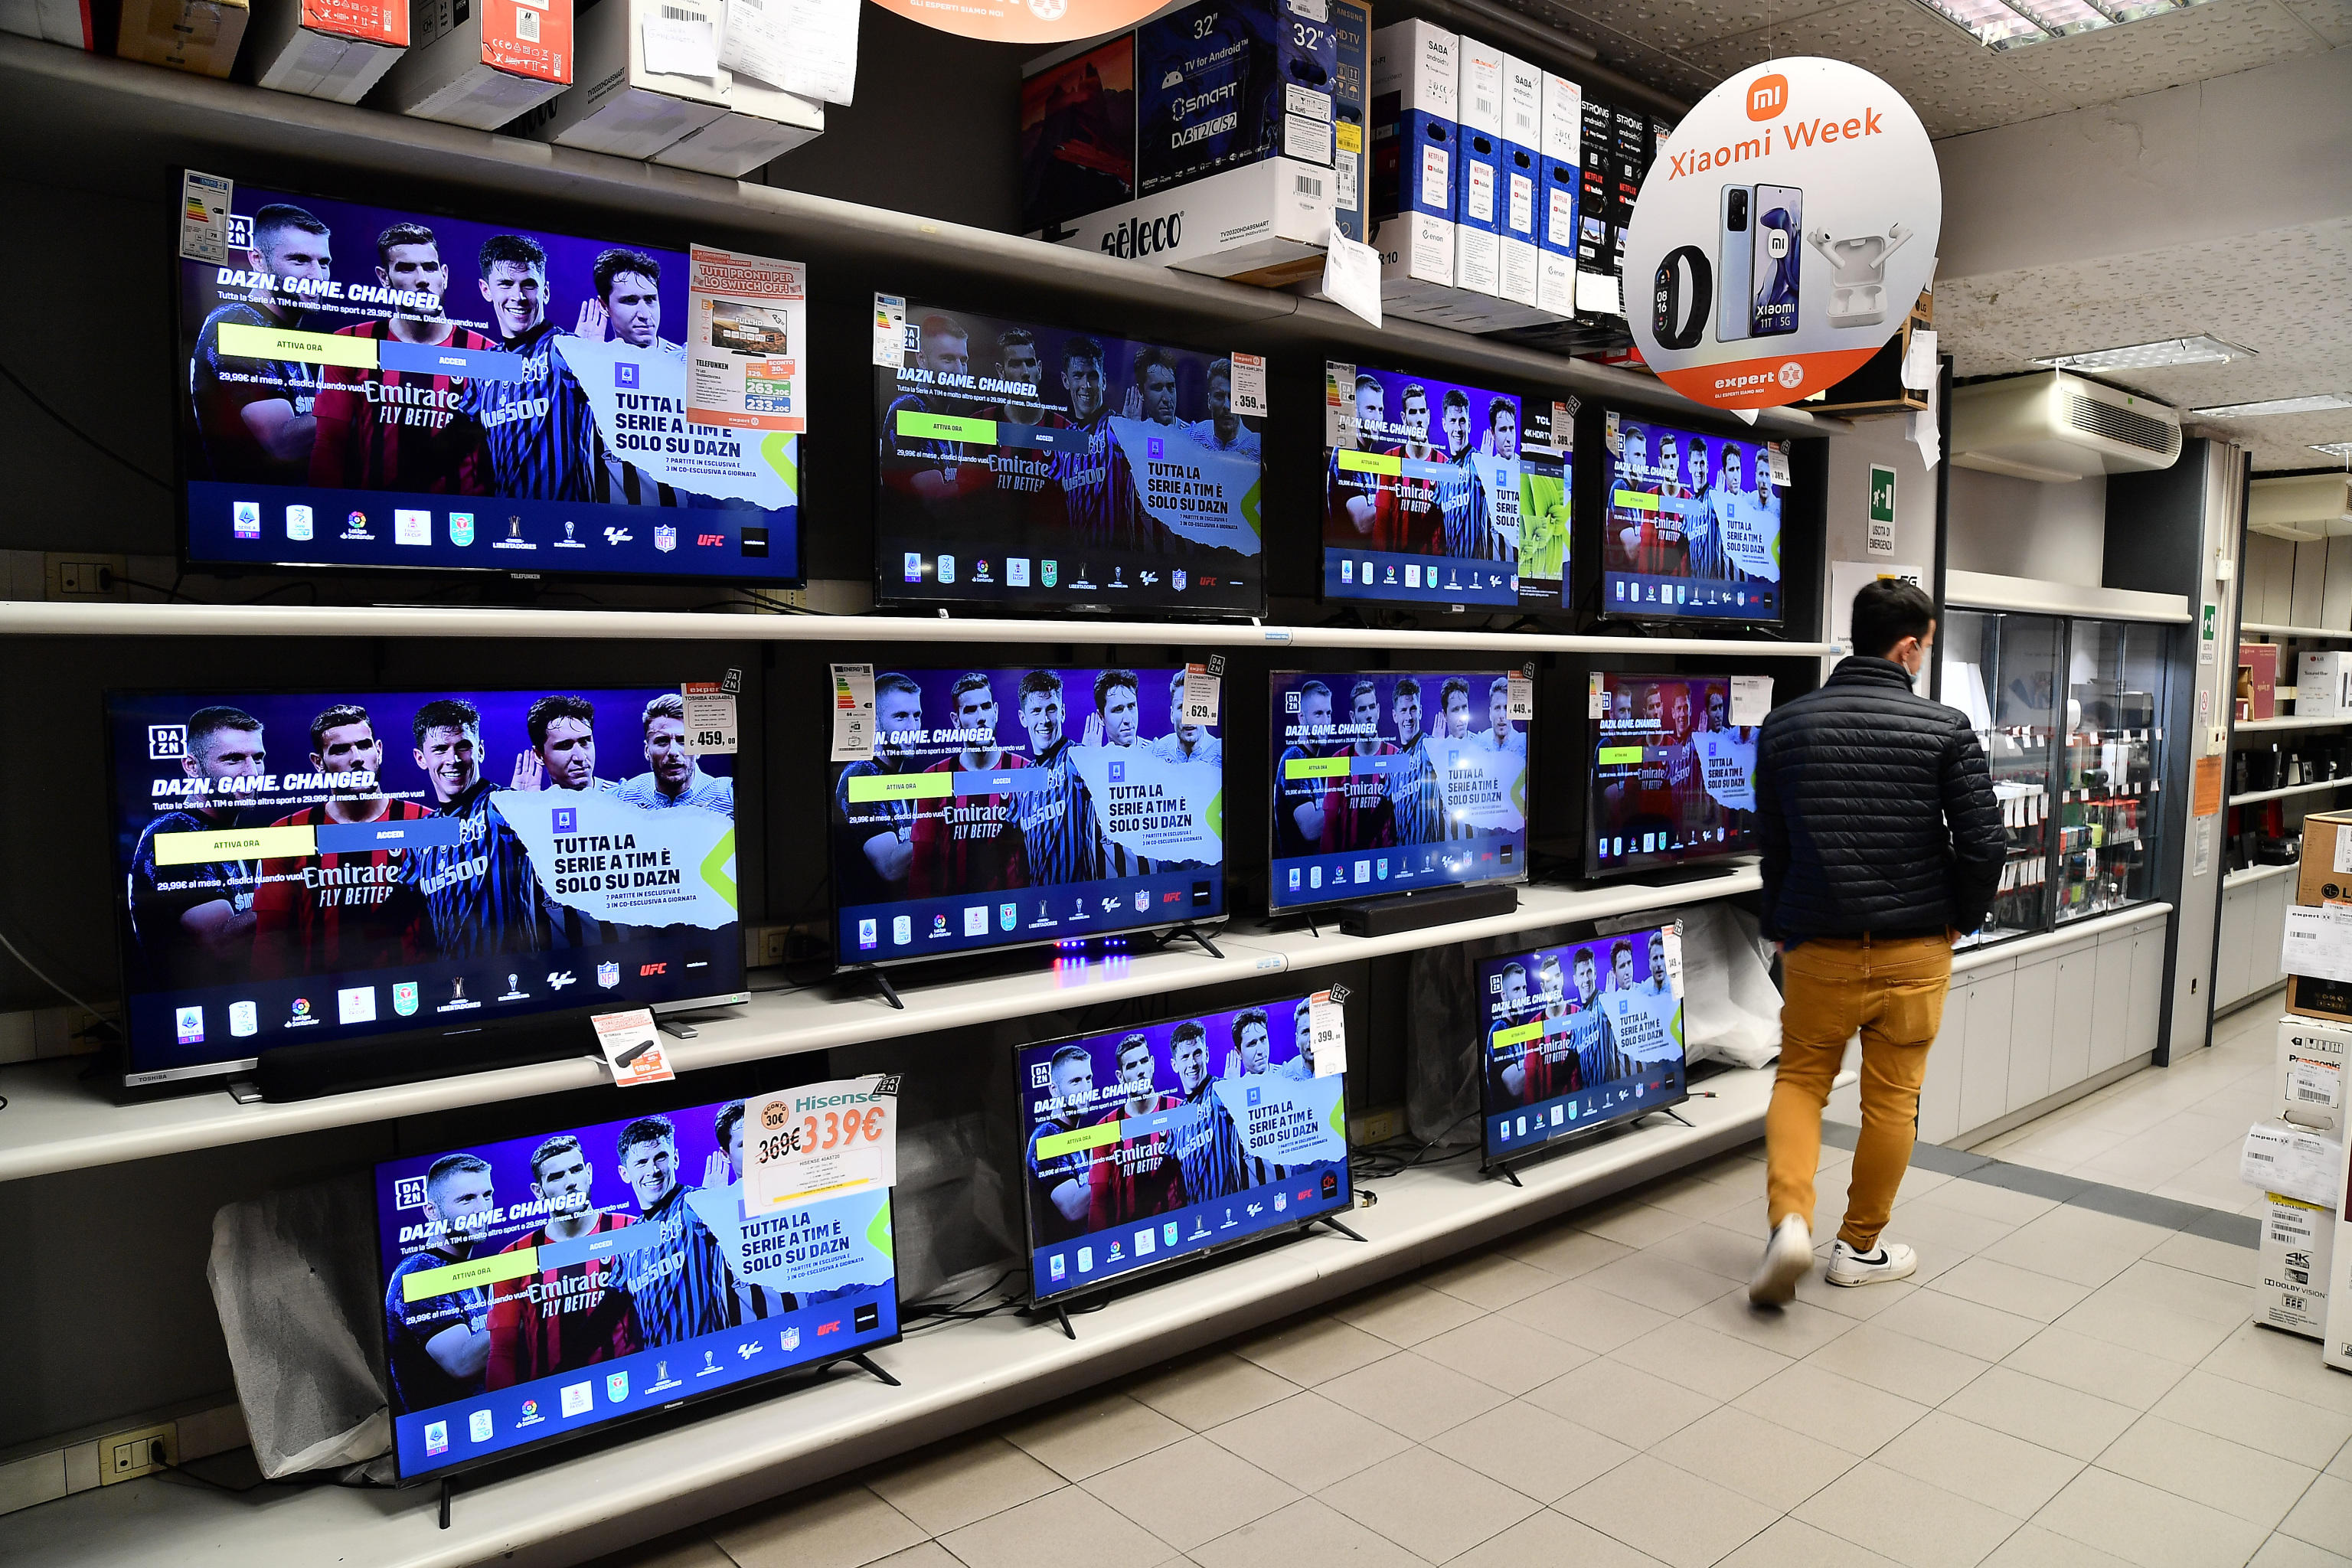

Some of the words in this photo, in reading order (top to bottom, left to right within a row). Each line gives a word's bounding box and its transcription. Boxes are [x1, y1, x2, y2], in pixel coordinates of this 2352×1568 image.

[926, 1, 959, 12] ESPERTI
[960, 6, 987, 15] SIAMO
[1336, 8, 1363, 22] AMSUNG
[1194, 12, 1217, 40] 32"
[1293, 23, 1324, 51] 32"
[1428, 41, 1449, 56] SABA
[1184, 60, 1195, 73] TV
[1197, 56, 1209, 69] for
[1515, 75, 1533, 90] SABA
[1295, 106, 1306, 115] RoHS
[1582, 100, 1610, 118] STRONG
[1616, 113, 1643, 132] STRONG
[1668, 129, 1772, 181] Xiaomi
[1784, 107, 1883, 150] Week
[1428, 152, 1444, 163] NETFLIX
[1474, 166, 1489, 177] NETFLIX
[1584, 171, 1603, 185] NETFLIX
[1619, 181, 1637, 196] NETFLIX
[1430, 234, 1443, 243] erion
[699, 265, 728, 278] TUTTI
[730, 269, 770, 283] PRONTI
[773, 272, 794, 283] PER
[217, 267, 279, 292] DAZN.
[283, 275, 345, 299] GAME.
[348, 283, 443, 311] CHANGED.
[704, 276, 720, 287] LO
[721, 278, 761, 292] SWITCH
[763, 283, 789, 294] OFF!
[1657, 291, 1668, 303] 08
[1657, 302, 1668, 314] 16
[1920, 303, 1927, 313] LG
[1760, 317, 1772, 328] 11T
[1780, 315, 1791, 327] 5G
[695, 359, 729, 370] TELEFUNKEN
[897, 365, 935, 384] DAZN.
[937, 371, 976, 390] GAME.
[978, 377, 1039, 397] CHANGED.
[1715, 372, 1774, 390] expert
[1535, 415, 1550, 426] TCL
[1873, 525, 1886, 536] USCITA
[1870, 538, 1893, 550] EMERGENZA
[890, 730, 930, 744] GAME.
[933, 727, 995, 743] CHANGED.
[151, 777, 214, 796] DAZN.
[217, 774, 279, 793] GAME.
[283, 770, 378, 790] CHANGED.
[152, 802, 174, 811] Tutta
[184, 801, 204, 809] Serie
[276, 796, 295, 806] sport
[384, 791, 409, 800] quando
[376, 829, 404, 839] ACCEDI
[214, 841, 241, 849] ATTIVA
[243, 839, 260, 848] ORA
[554, 835, 610, 854] TUTTA
[614, 833, 635, 850] LA
[554, 855, 607, 875] SERIE
[610, 854, 626, 871] A
[627, 851, 658, 869] TIM
[661, 847, 671, 867] È
[302, 859, 402, 889] Emirate
[554, 875, 600, 894] SOLO
[606, 873, 628, 890] SU
[633, 868, 681, 887] DAZN
[318, 889, 344, 908] FLY
[619, 898, 662, 907] CO-ESCLUSIVA
[668, 894, 697, 903] GIORNATA
[639, 962, 668, 976] UFC
[1621, 1036, 1636, 1048] SOLO
[1638, 1033, 1645, 1044] SU
[1647, 1028, 1664, 1041] DAZN
[139, 1073, 168, 1083] TOSHIBA
[795, 1093, 881, 1113] Hisense
[766, 1112, 784, 1127] 30€
[801, 1106, 885, 1154] 339€
[1250, 1132, 1275, 1150] SOLO
[1277, 1129, 1290, 1142] SU
[1292, 1121, 1318, 1138] DAZN
[2250, 1133, 2278, 1142] expert
[799, 1158, 820, 1167] HISENSE
[398, 1218, 451, 1243] DAZN.
[453, 1207, 507, 1232] GAME.
[508, 1190, 590, 1220] CHANGED.
[2285, 1252, 2310, 1264] 4K
[2275, 1281, 2300, 1292] DOLBY
